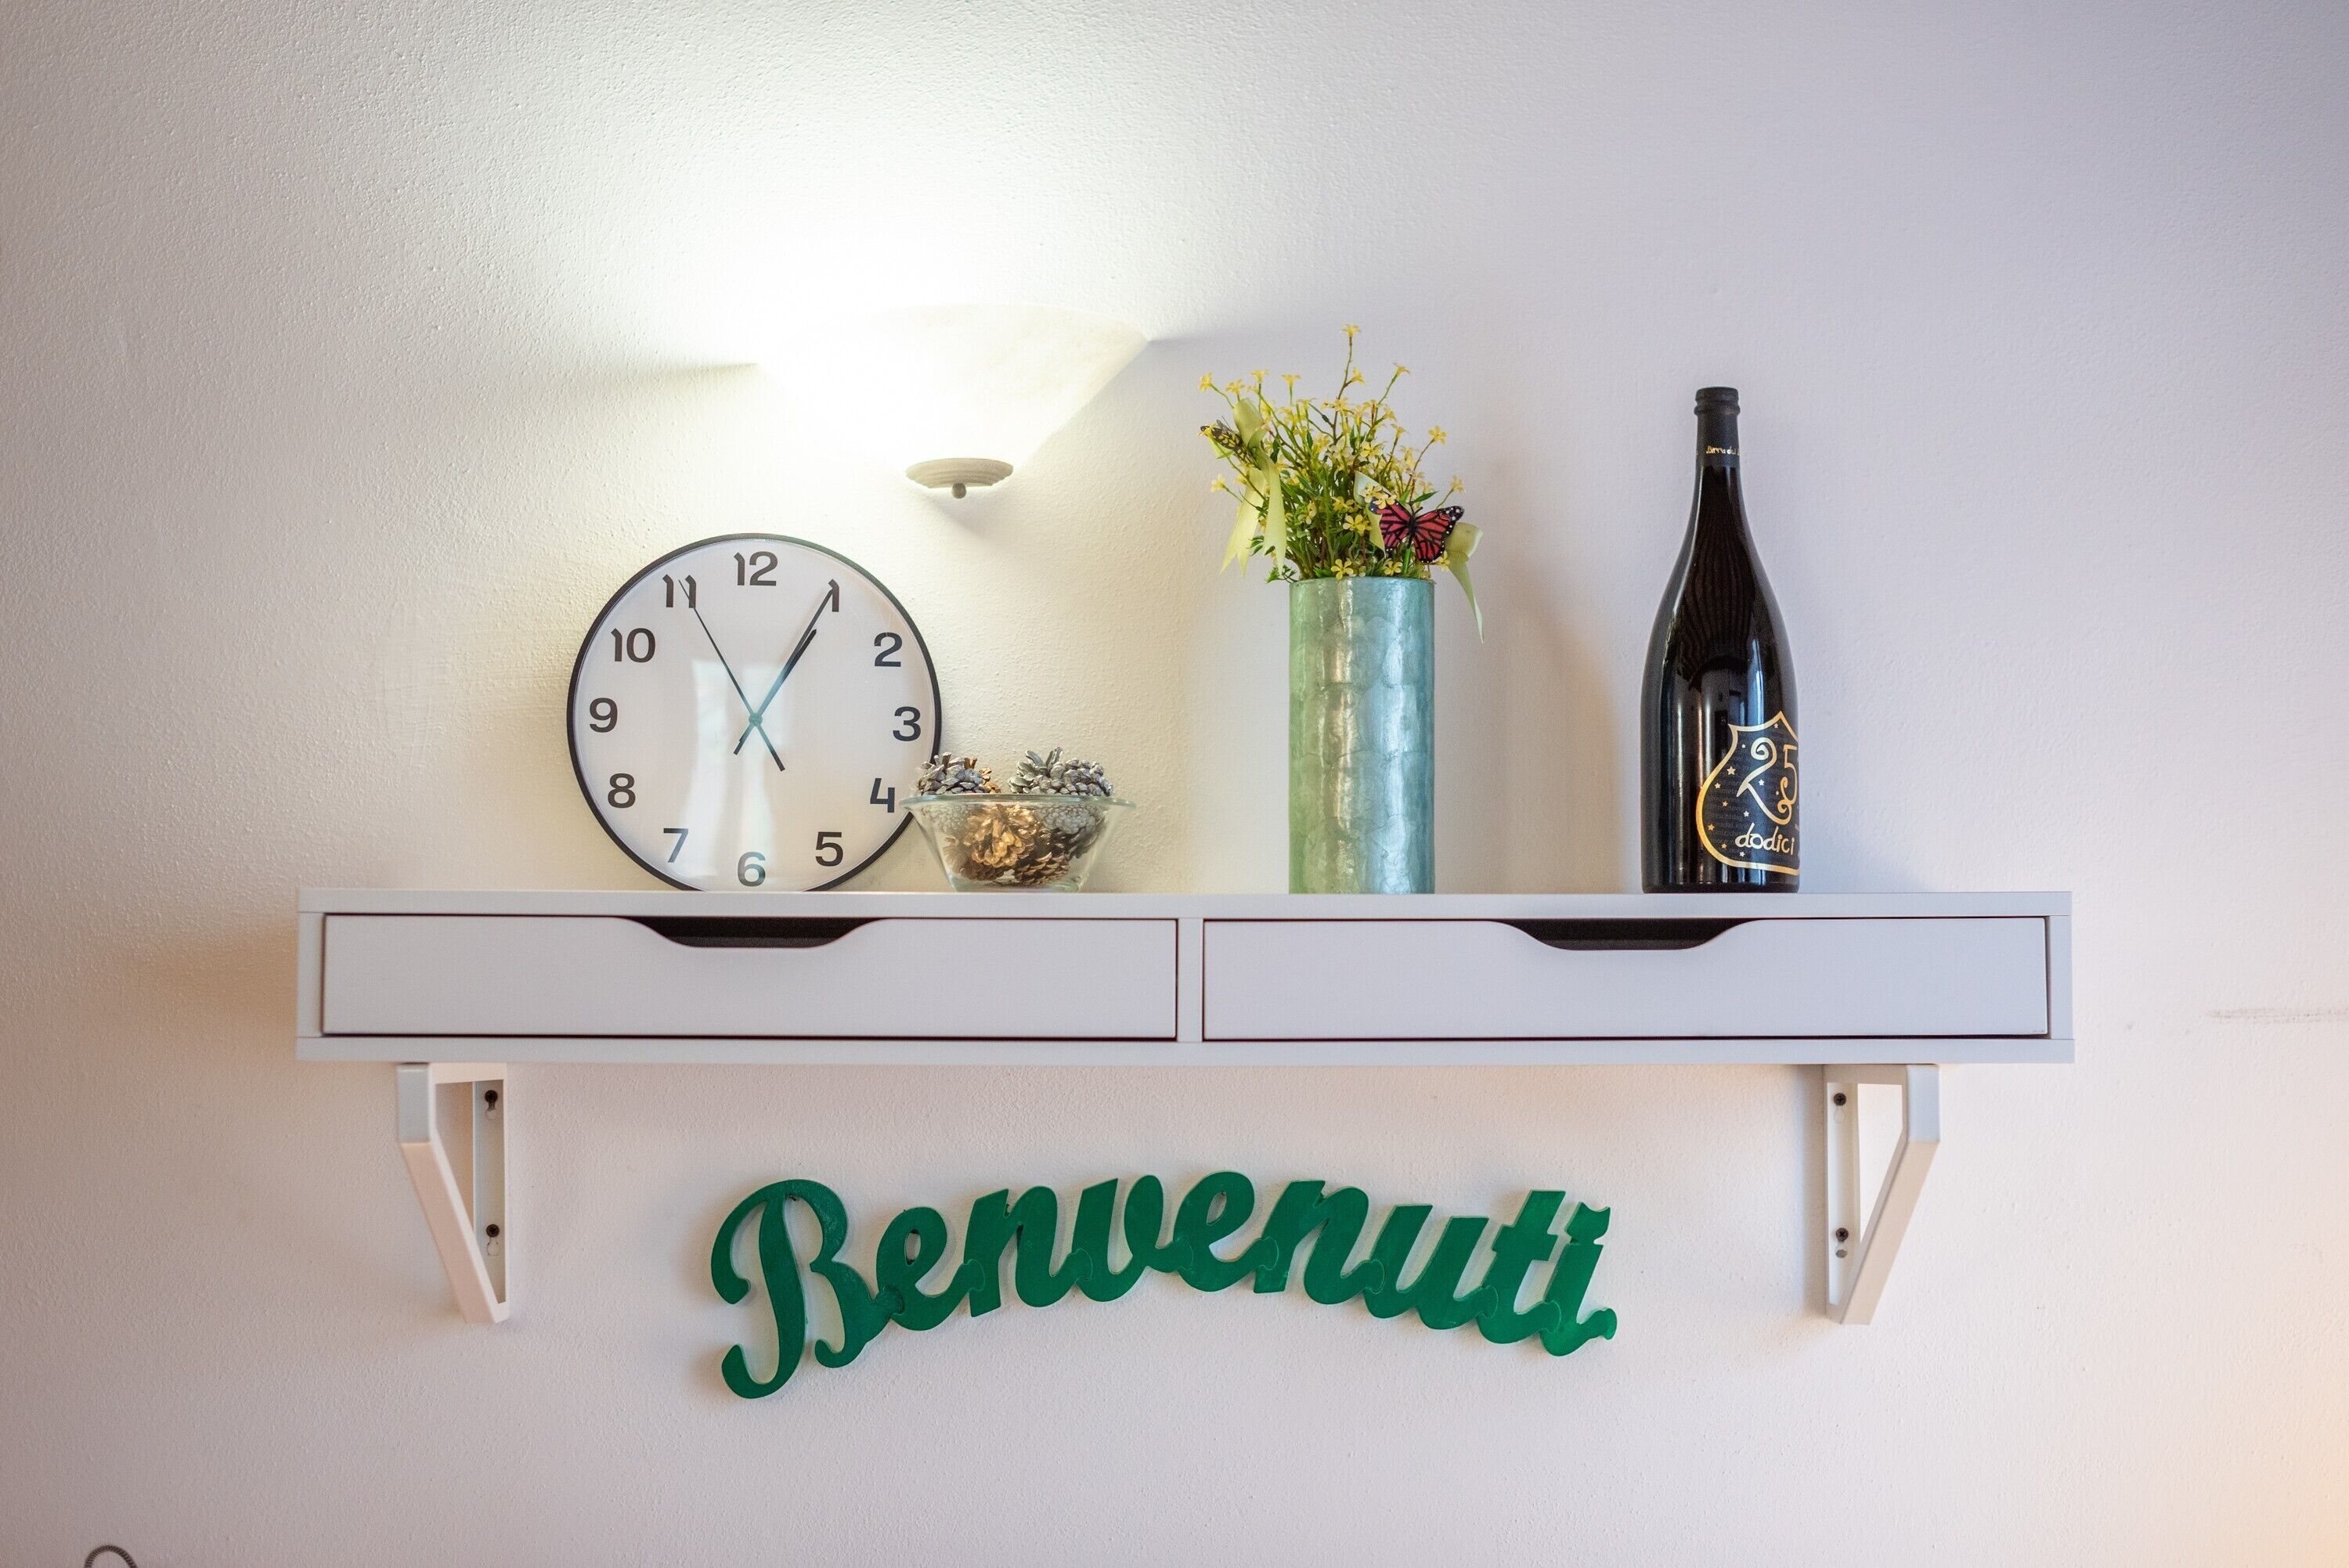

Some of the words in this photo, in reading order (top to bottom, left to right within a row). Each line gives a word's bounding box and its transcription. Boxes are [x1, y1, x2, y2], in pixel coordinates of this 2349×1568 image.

[733, 551, 778, 586] 12
[662, 574, 697, 608] 11
[828, 579, 840, 612] 1
[611, 628, 656, 663] 10
[873, 632, 903, 668] 2
[589, 697, 619, 734] 9
[893, 706, 922, 742] 3
[607, 773, 636, 809] 8
[869, 777, 896, 813] 4
[662, 827, 689, 863] 7
[815, 831, 844, 867] 5
[1734, 822, 1795, 856] dodici
[737, 852, 767, 888] 6
[710, 1170, 1618, 1400] Benvenuti
